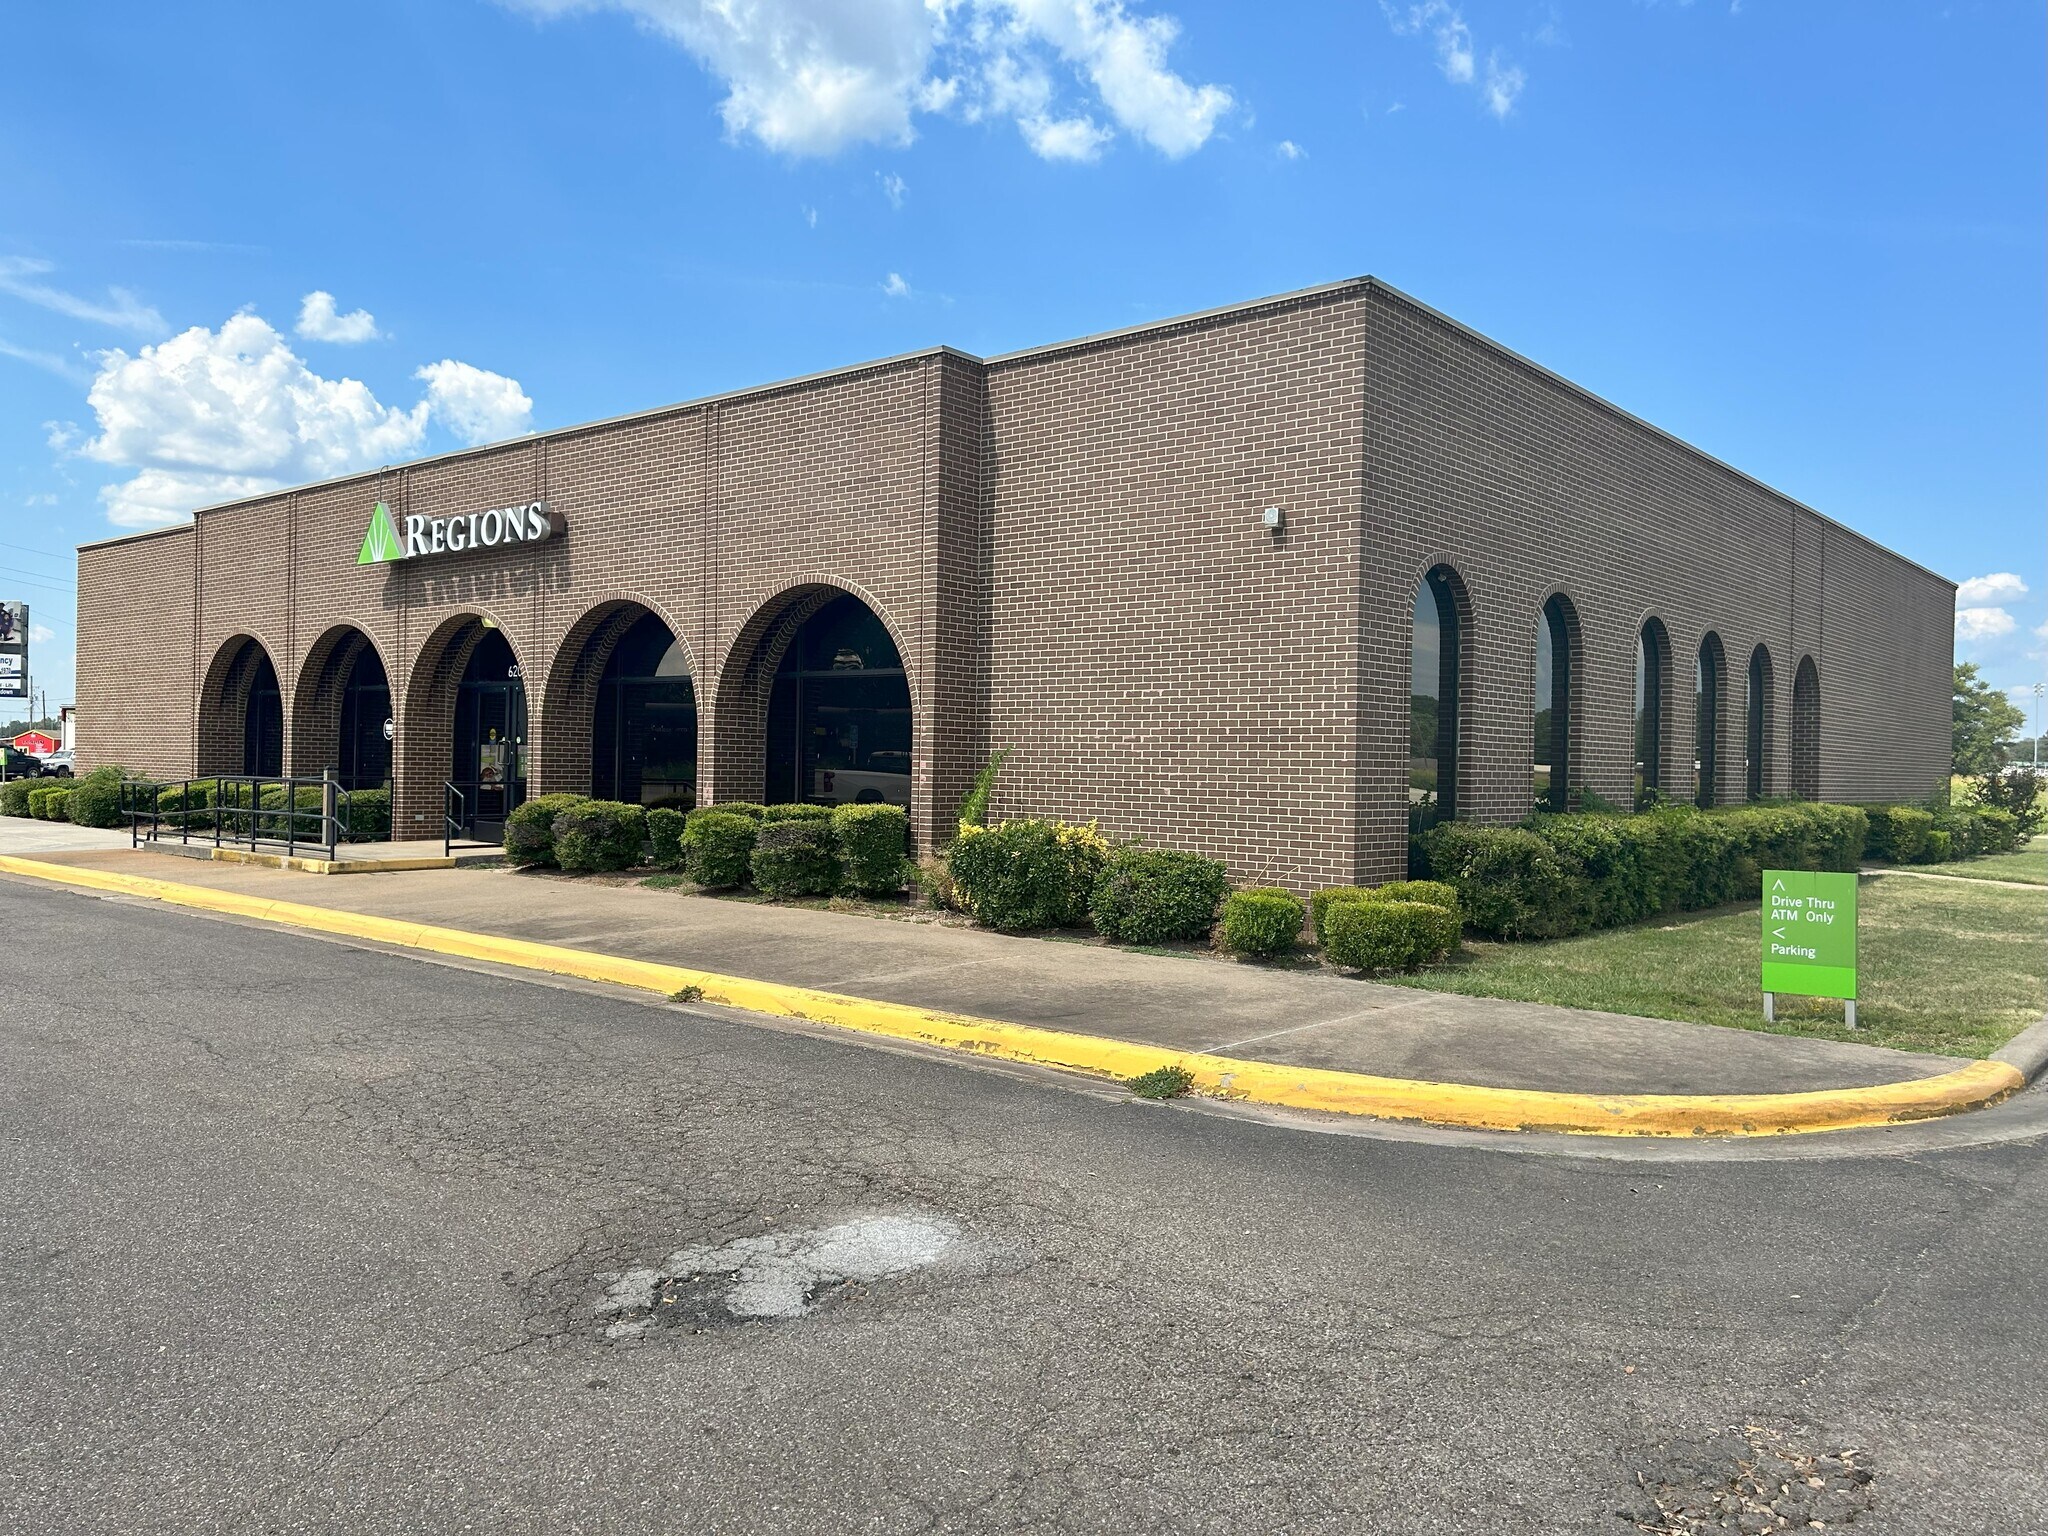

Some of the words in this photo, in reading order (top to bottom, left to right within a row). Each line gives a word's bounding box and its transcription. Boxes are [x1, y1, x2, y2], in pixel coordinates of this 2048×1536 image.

[405, 501, 543, 557] REGIONS
[1771, 895, 1803, 908] Drive
[1806, 897, 1835, 909] Thru
[1771, 909, 1798, 921] ATM
[1806, 911, 1834, 925] Only
[1771, 943, 1816, 959] Parking
